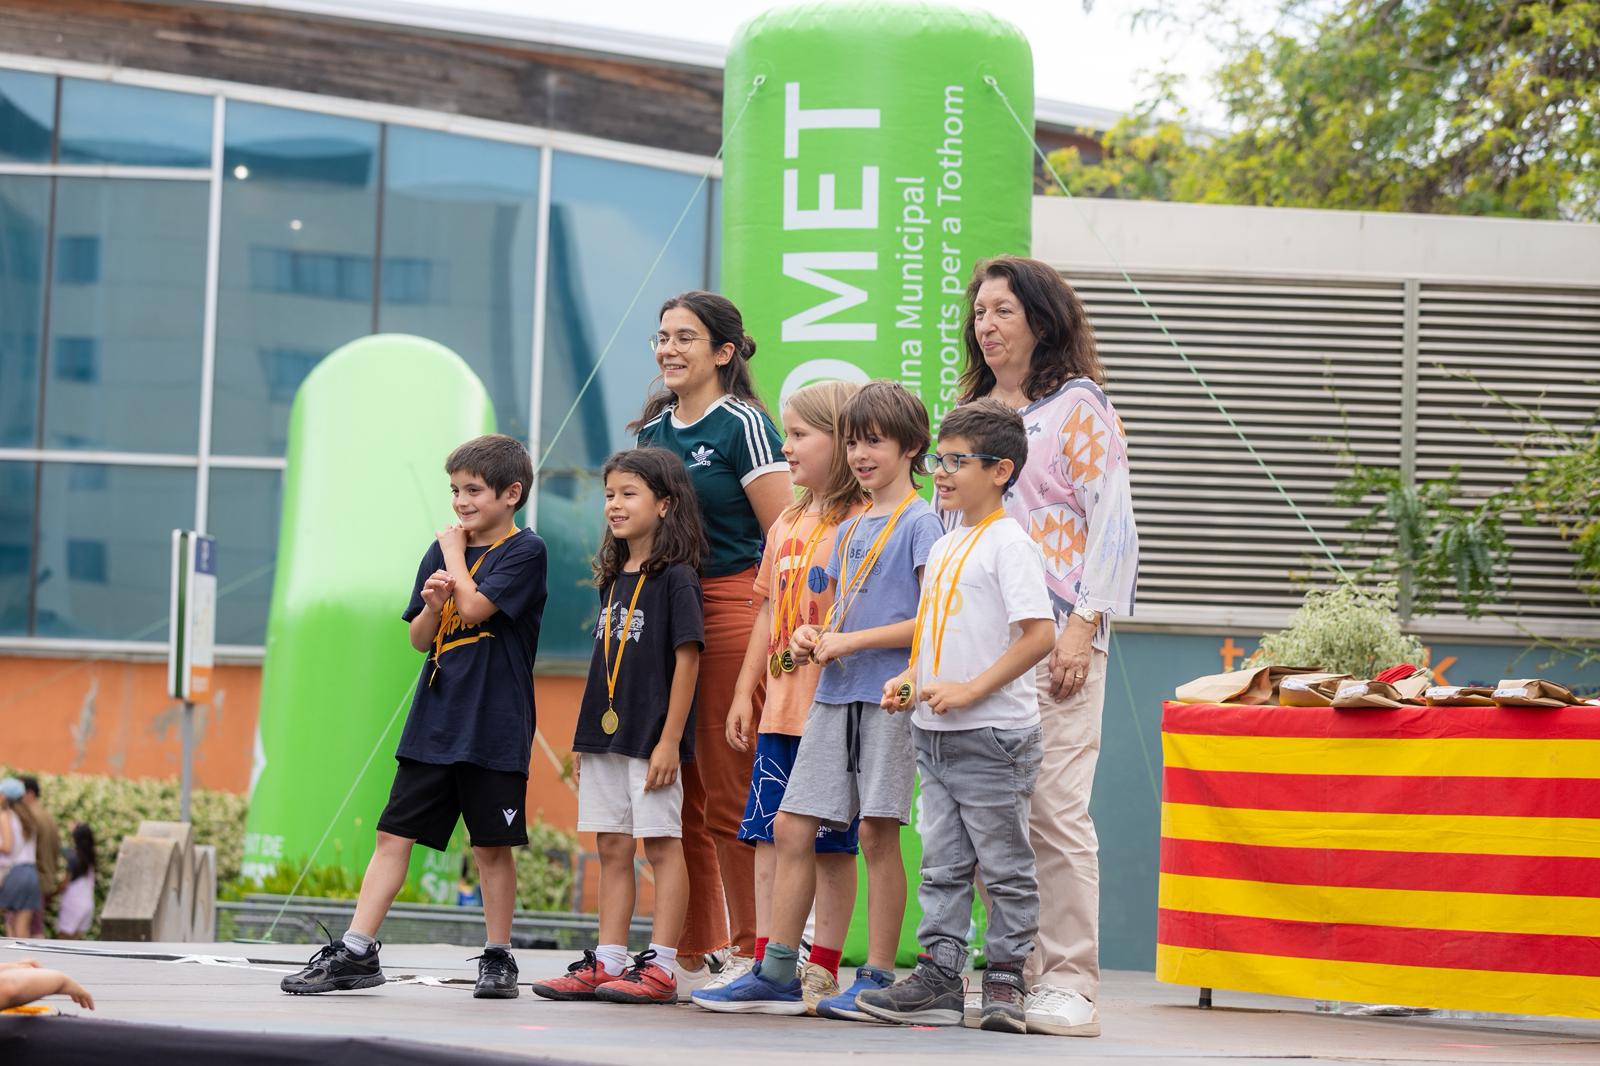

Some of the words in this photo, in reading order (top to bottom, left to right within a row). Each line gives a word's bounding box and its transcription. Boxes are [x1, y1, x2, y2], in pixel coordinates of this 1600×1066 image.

[936, 85, 964, 207] Tothom
[896, 176, 931, 329] Municipal
[941, 241, 966, 295] per
[943, 217, 961, 234] a
